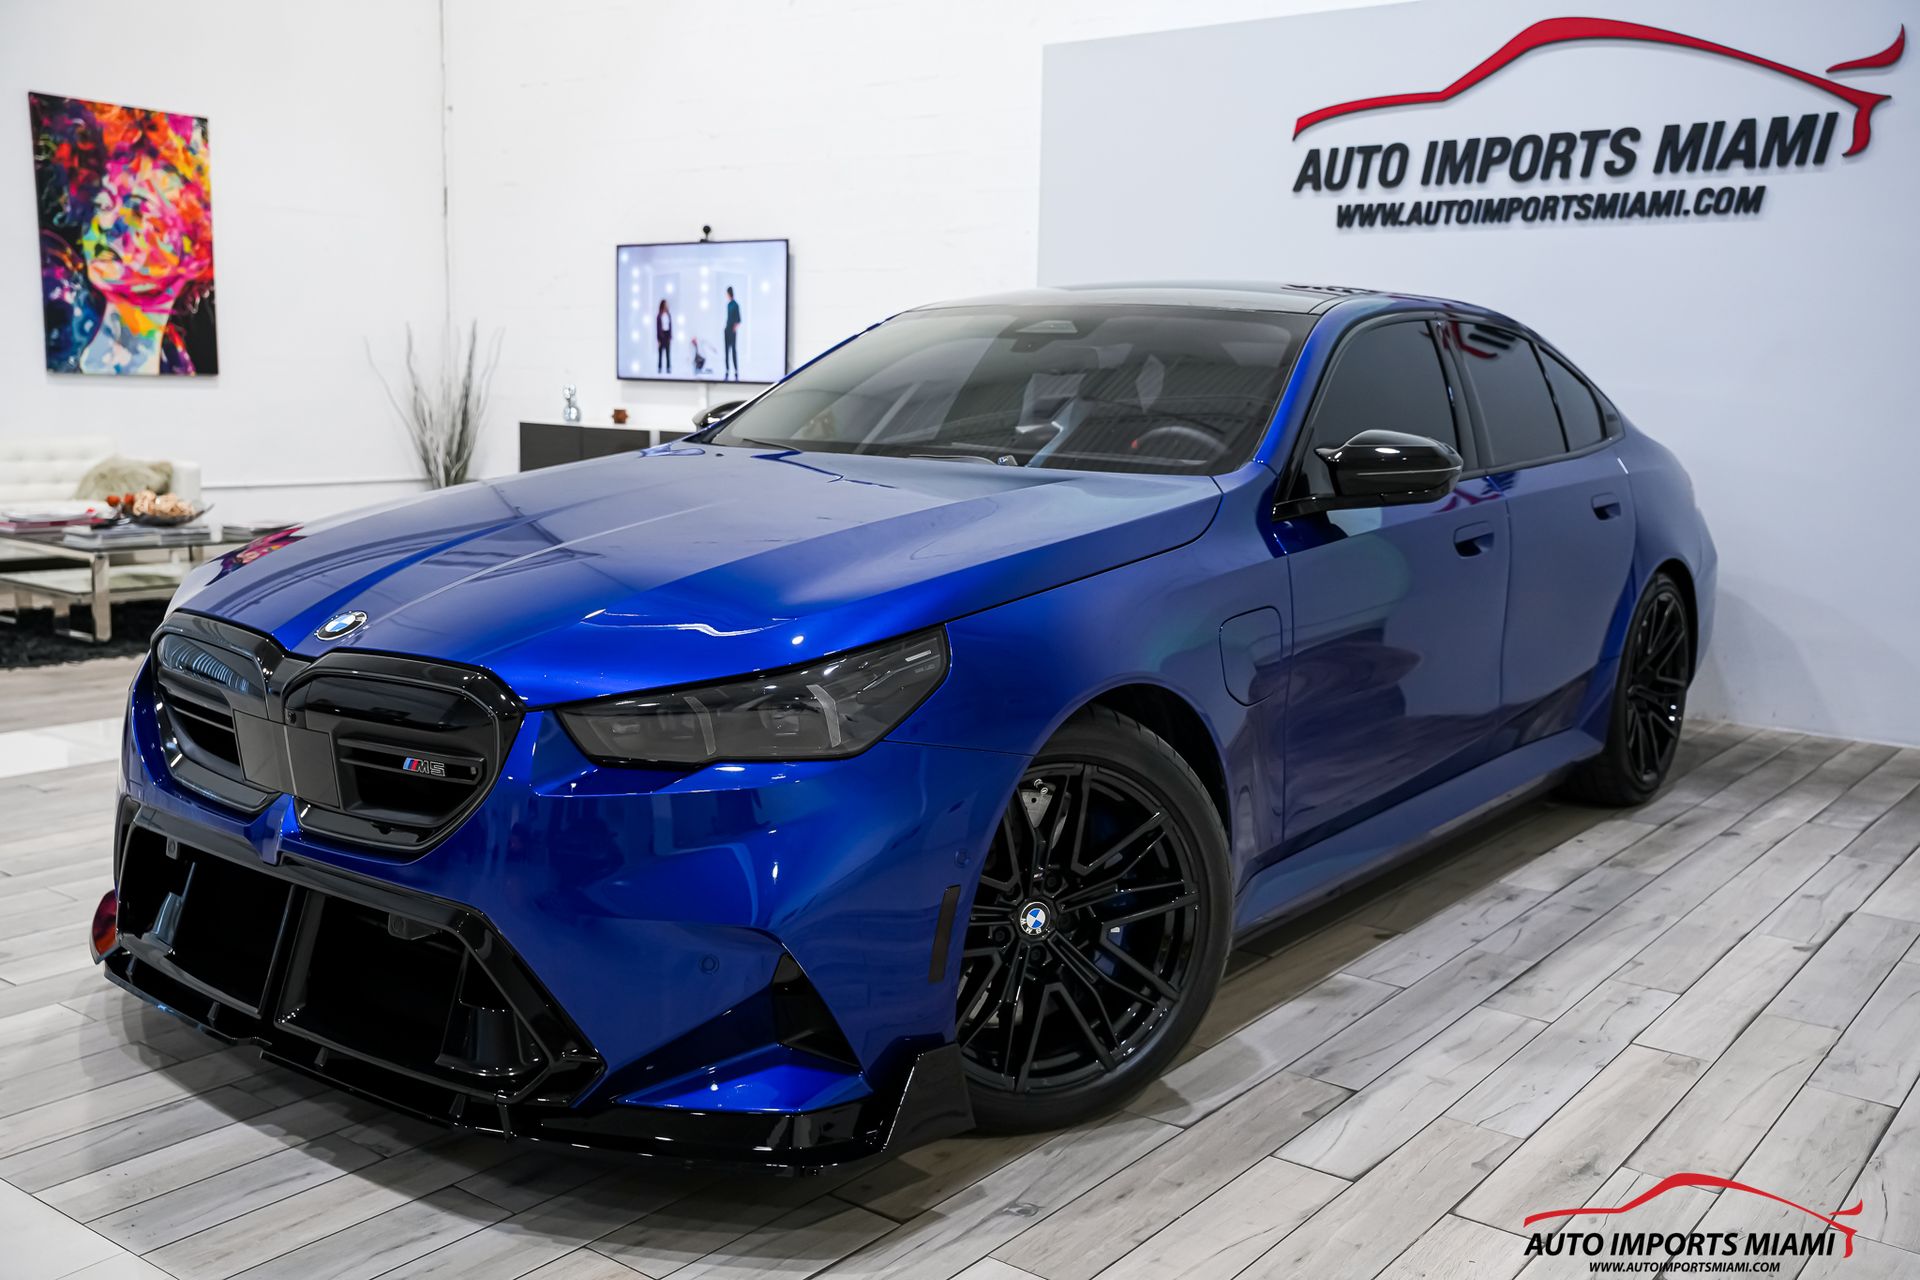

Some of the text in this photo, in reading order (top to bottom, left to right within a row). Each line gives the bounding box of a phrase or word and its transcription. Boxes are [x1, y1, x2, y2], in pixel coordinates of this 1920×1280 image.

[1292, 111, 1840, 193] AUTO IMPORTS MIAMI
[1335, 185, 1767, 229] WWW.AUTOIMPORTSMIAMI.COM
[403, 757, 446, 777] M5
